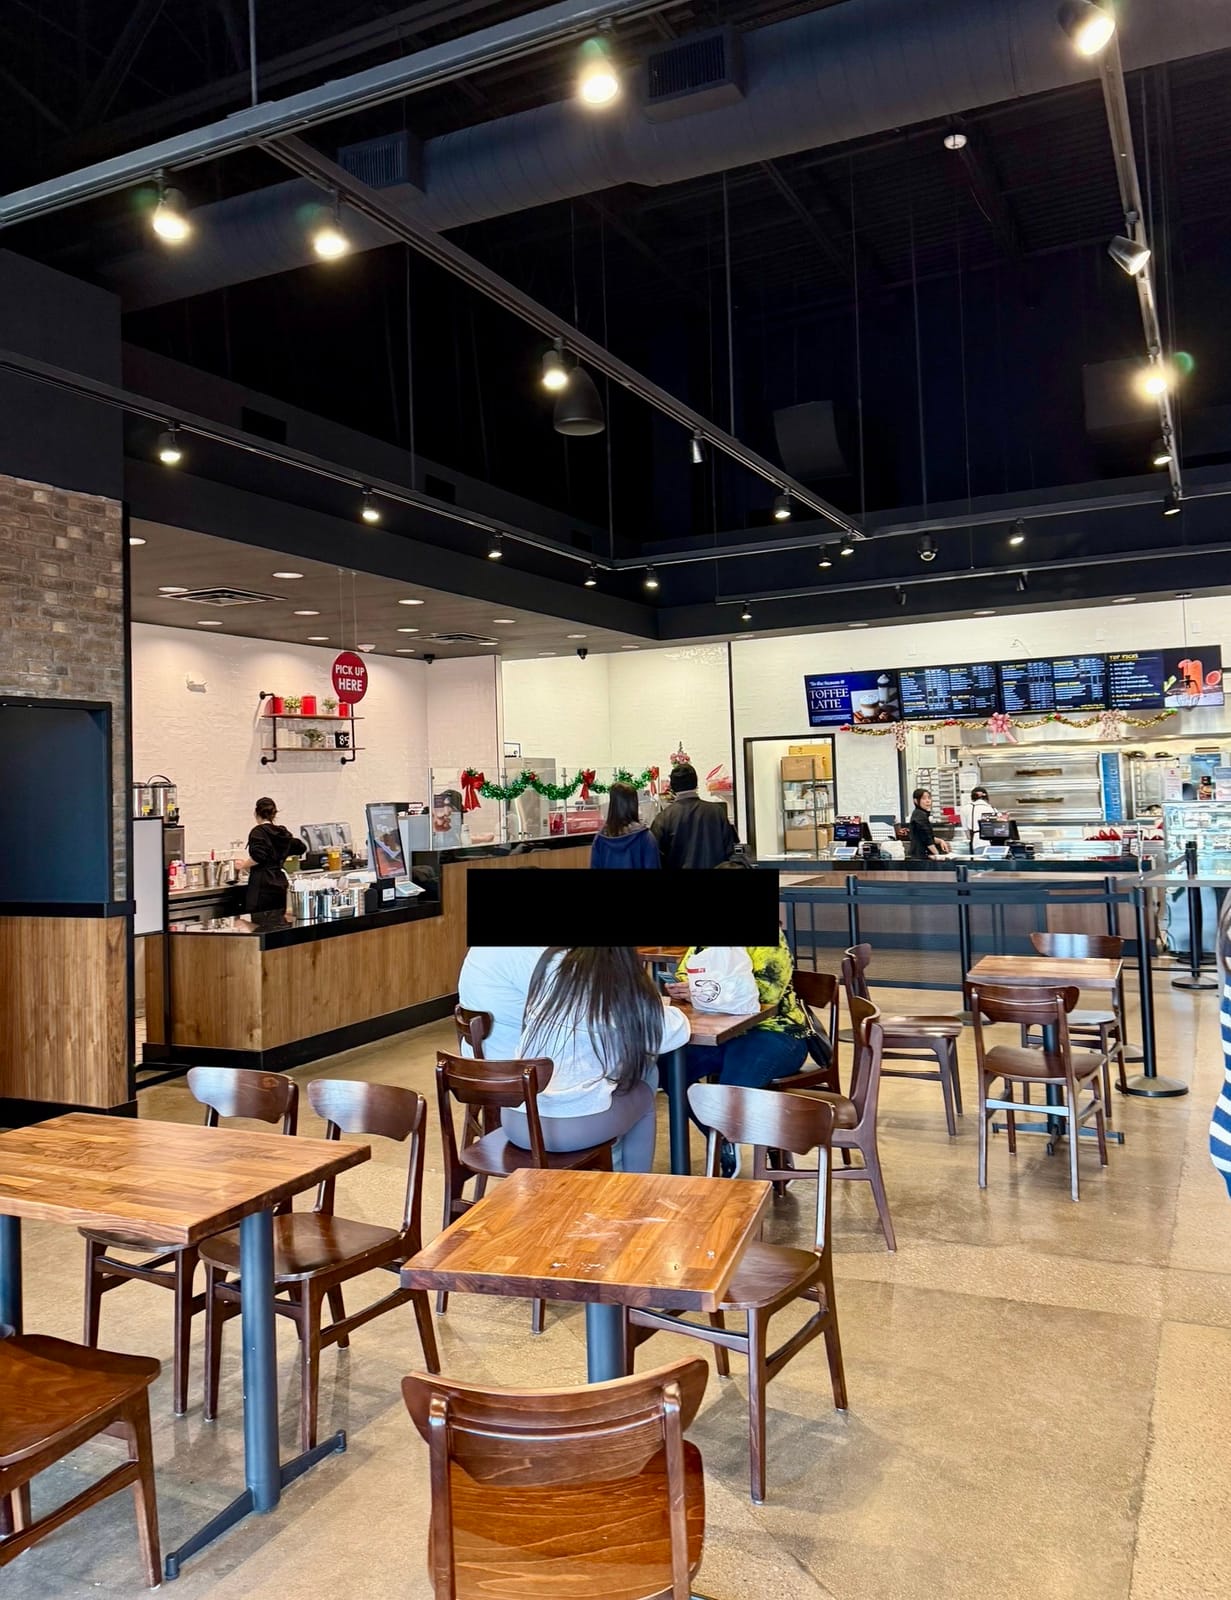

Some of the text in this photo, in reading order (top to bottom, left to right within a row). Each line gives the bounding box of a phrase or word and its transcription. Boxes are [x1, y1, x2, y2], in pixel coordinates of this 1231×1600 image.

[335, 664, 365, 677] PICK UP
[338, 678, 363, 692] HERE
[808, 688, 849, 699] TOFFEE
[811, 699, 842, 709] LATTE
